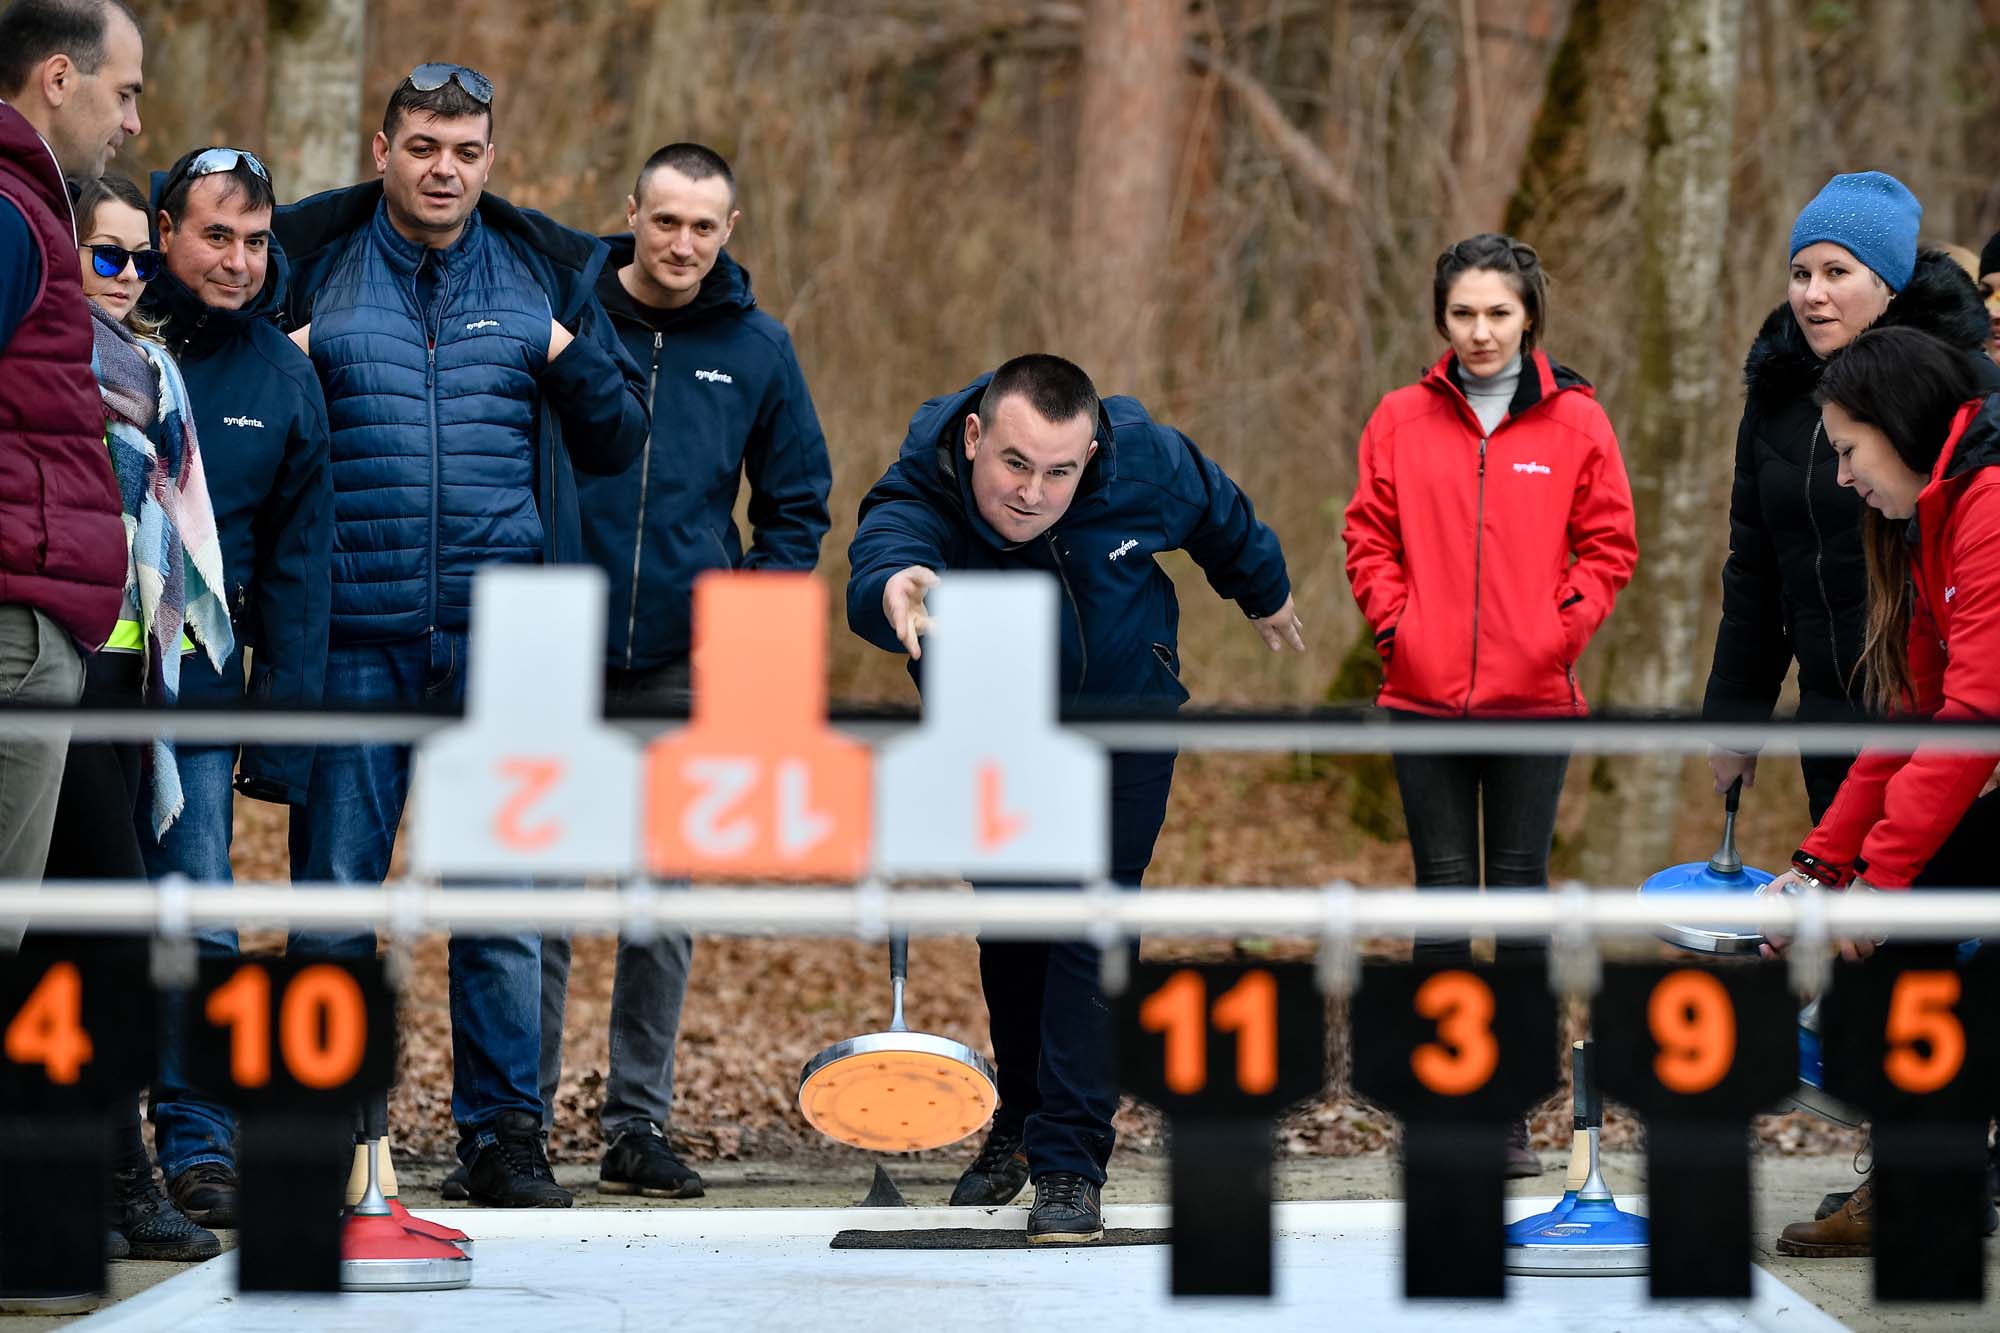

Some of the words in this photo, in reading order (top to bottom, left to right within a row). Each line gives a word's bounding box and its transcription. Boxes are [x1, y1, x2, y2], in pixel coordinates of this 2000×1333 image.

[492, 757, 565, 852] 2
[682, 756, 834, 858] 12
[975, 760, 1025, 852] 1
[4, 962, 92, 1084] 4
[206, 965, 366, 1088] 10
[1140, 971, 1277, 1094] 11
[1411, 971, 1498, 1095] 3
[1648, 970, 1736, 1093] 9
[1884, 972, 1966, 1093] 5
